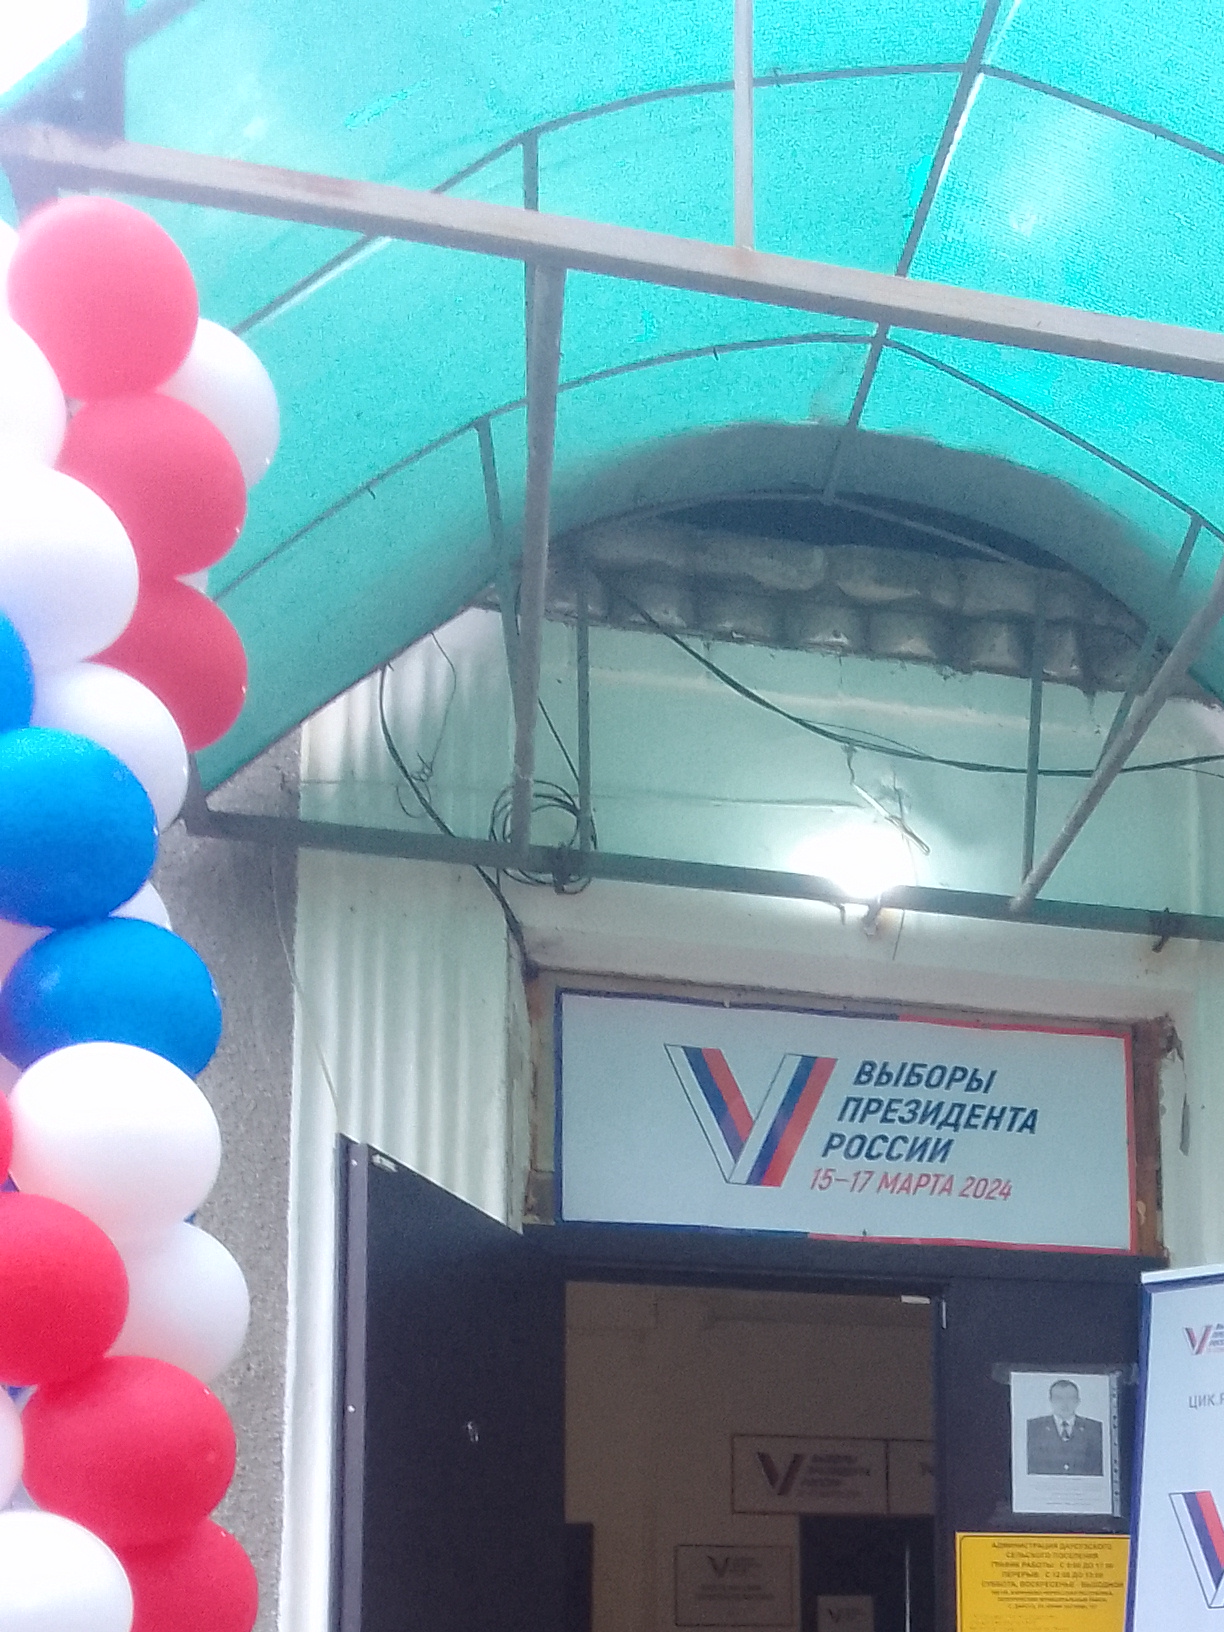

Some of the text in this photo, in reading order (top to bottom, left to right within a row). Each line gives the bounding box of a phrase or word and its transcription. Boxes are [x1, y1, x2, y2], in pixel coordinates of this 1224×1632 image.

[853, 1060, 998, 1094] ВЫБОРЫ
[837, 1097, 1039, 1135] ПРЕЗИДЕНТА
[822, 1133, 954, 1163] РОССИИ
[876, 1172, 955, 1198] МАРТА
[958, 1175, 1013, 1200] 2024
